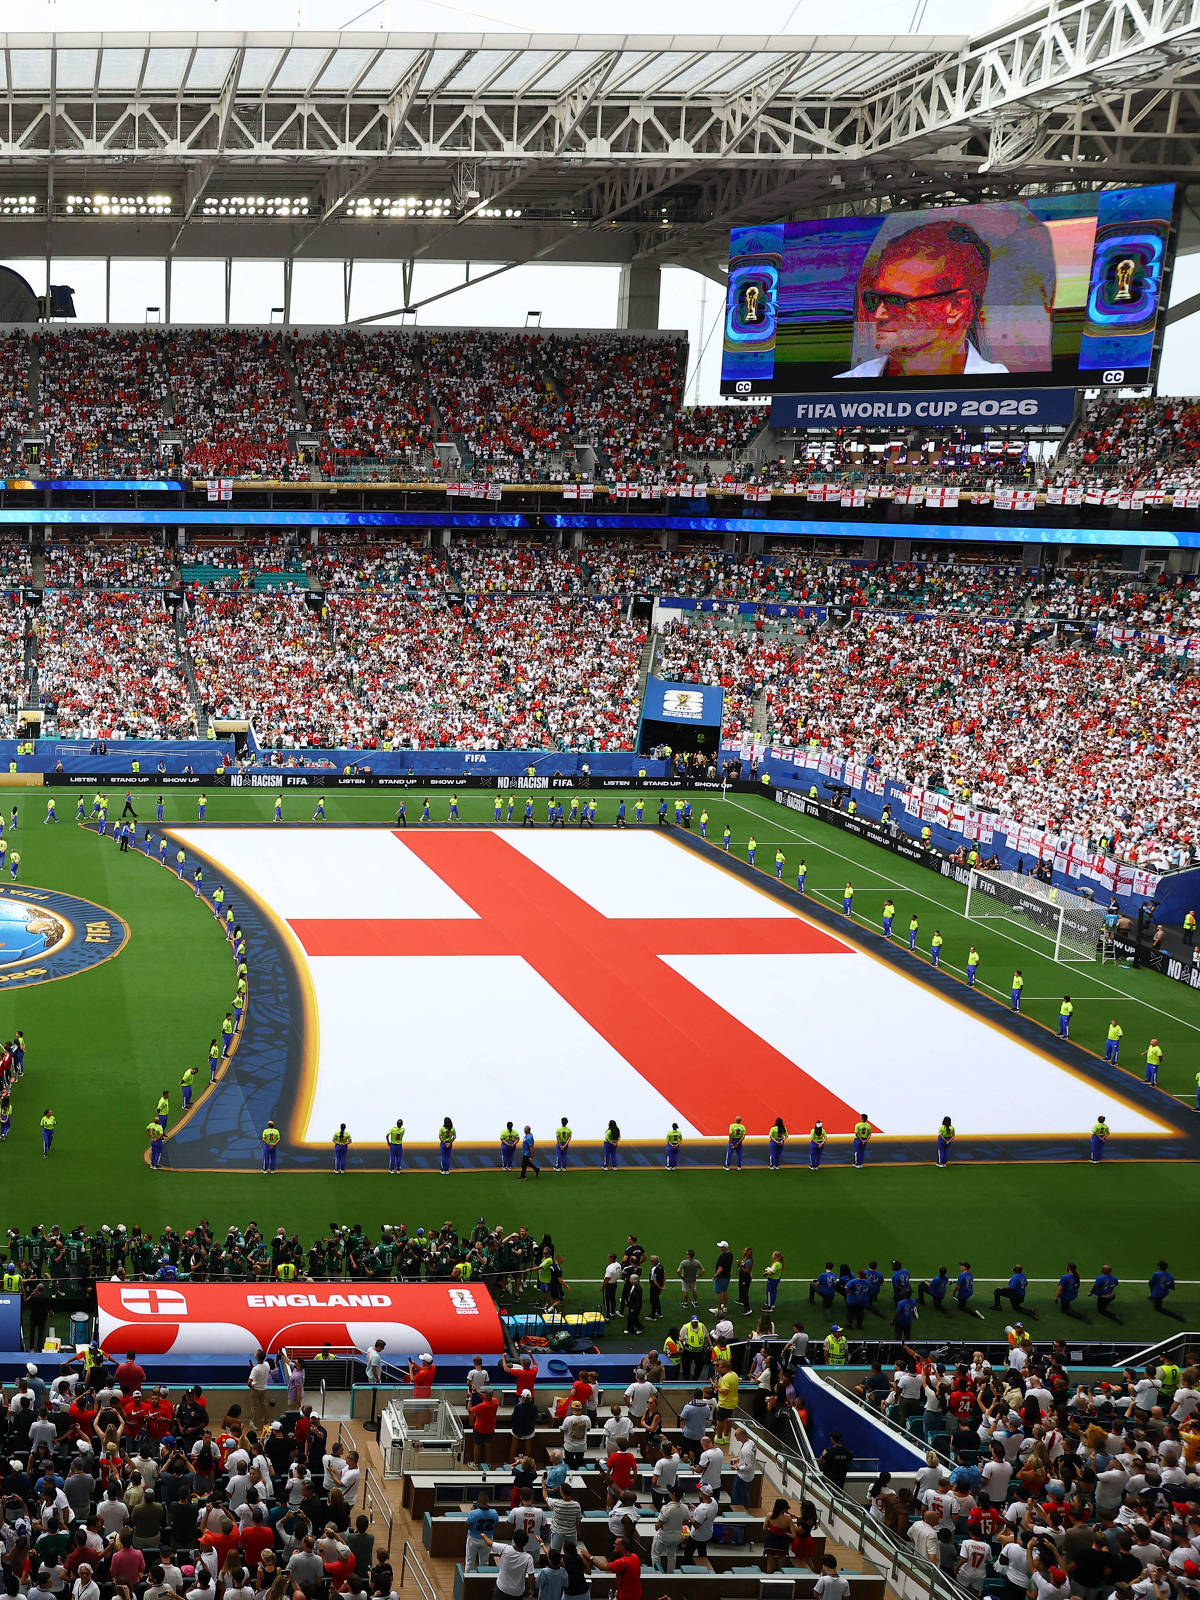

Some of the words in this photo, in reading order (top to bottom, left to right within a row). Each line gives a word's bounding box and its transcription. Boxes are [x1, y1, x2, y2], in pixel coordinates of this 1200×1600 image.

[1105, 373, 1122, 382] CC
[737, 383, 750, 391] CC
[796, 403, 836, 419] FIFA
[840, 402, 912, 418] WORLD
[915, 400, 957, 417] CUP
[961, 399, 1039, 416] 2026
[464, 754, 486, 763] FIFA
[231, 774, 242, 787] NO
[251, 774, 283, 787] RACISM
[287, 777, 308, 785] FIFA
[497, 777, 509, 789] NO
[517, 777, 549, 789] RACISM
[553, 779, 574, 787] FIFA
[775, 789, 783, 804] NO
[787, 794, 806, 814] RACISM
[806, 804, 819, 817] FIFA
[844, 822, 861, 833] LISTEN
[866, 831, 882, 844] STAND
[882, 837, 890, 845] UP
[897, 845, 913, 857] SHOW
[912, 851, 922, 859] UP
[941, 862, 950, 877] NO
[980, 880, 996, 895] FIFA
[10, 890, 50, 900] FIFA
[1020, 899, 1043, 913] LISTEN
[85, 920, 112, 943] FIFA
[1124, 943, 1136, 954] UP
[1167, 958, 1182, 980] NO
[246, 1294, 392, 1308] ENGLAND
[958, 1400, 970, 1413] 24
[931, 1504, 944, 1519] 15
[475, 1518, 495, 1532] 22
[523, 1519, 536, 1534] 12
[979, 1519, 993, 1535] 15
[971, 1552, 985, 1569] 17
